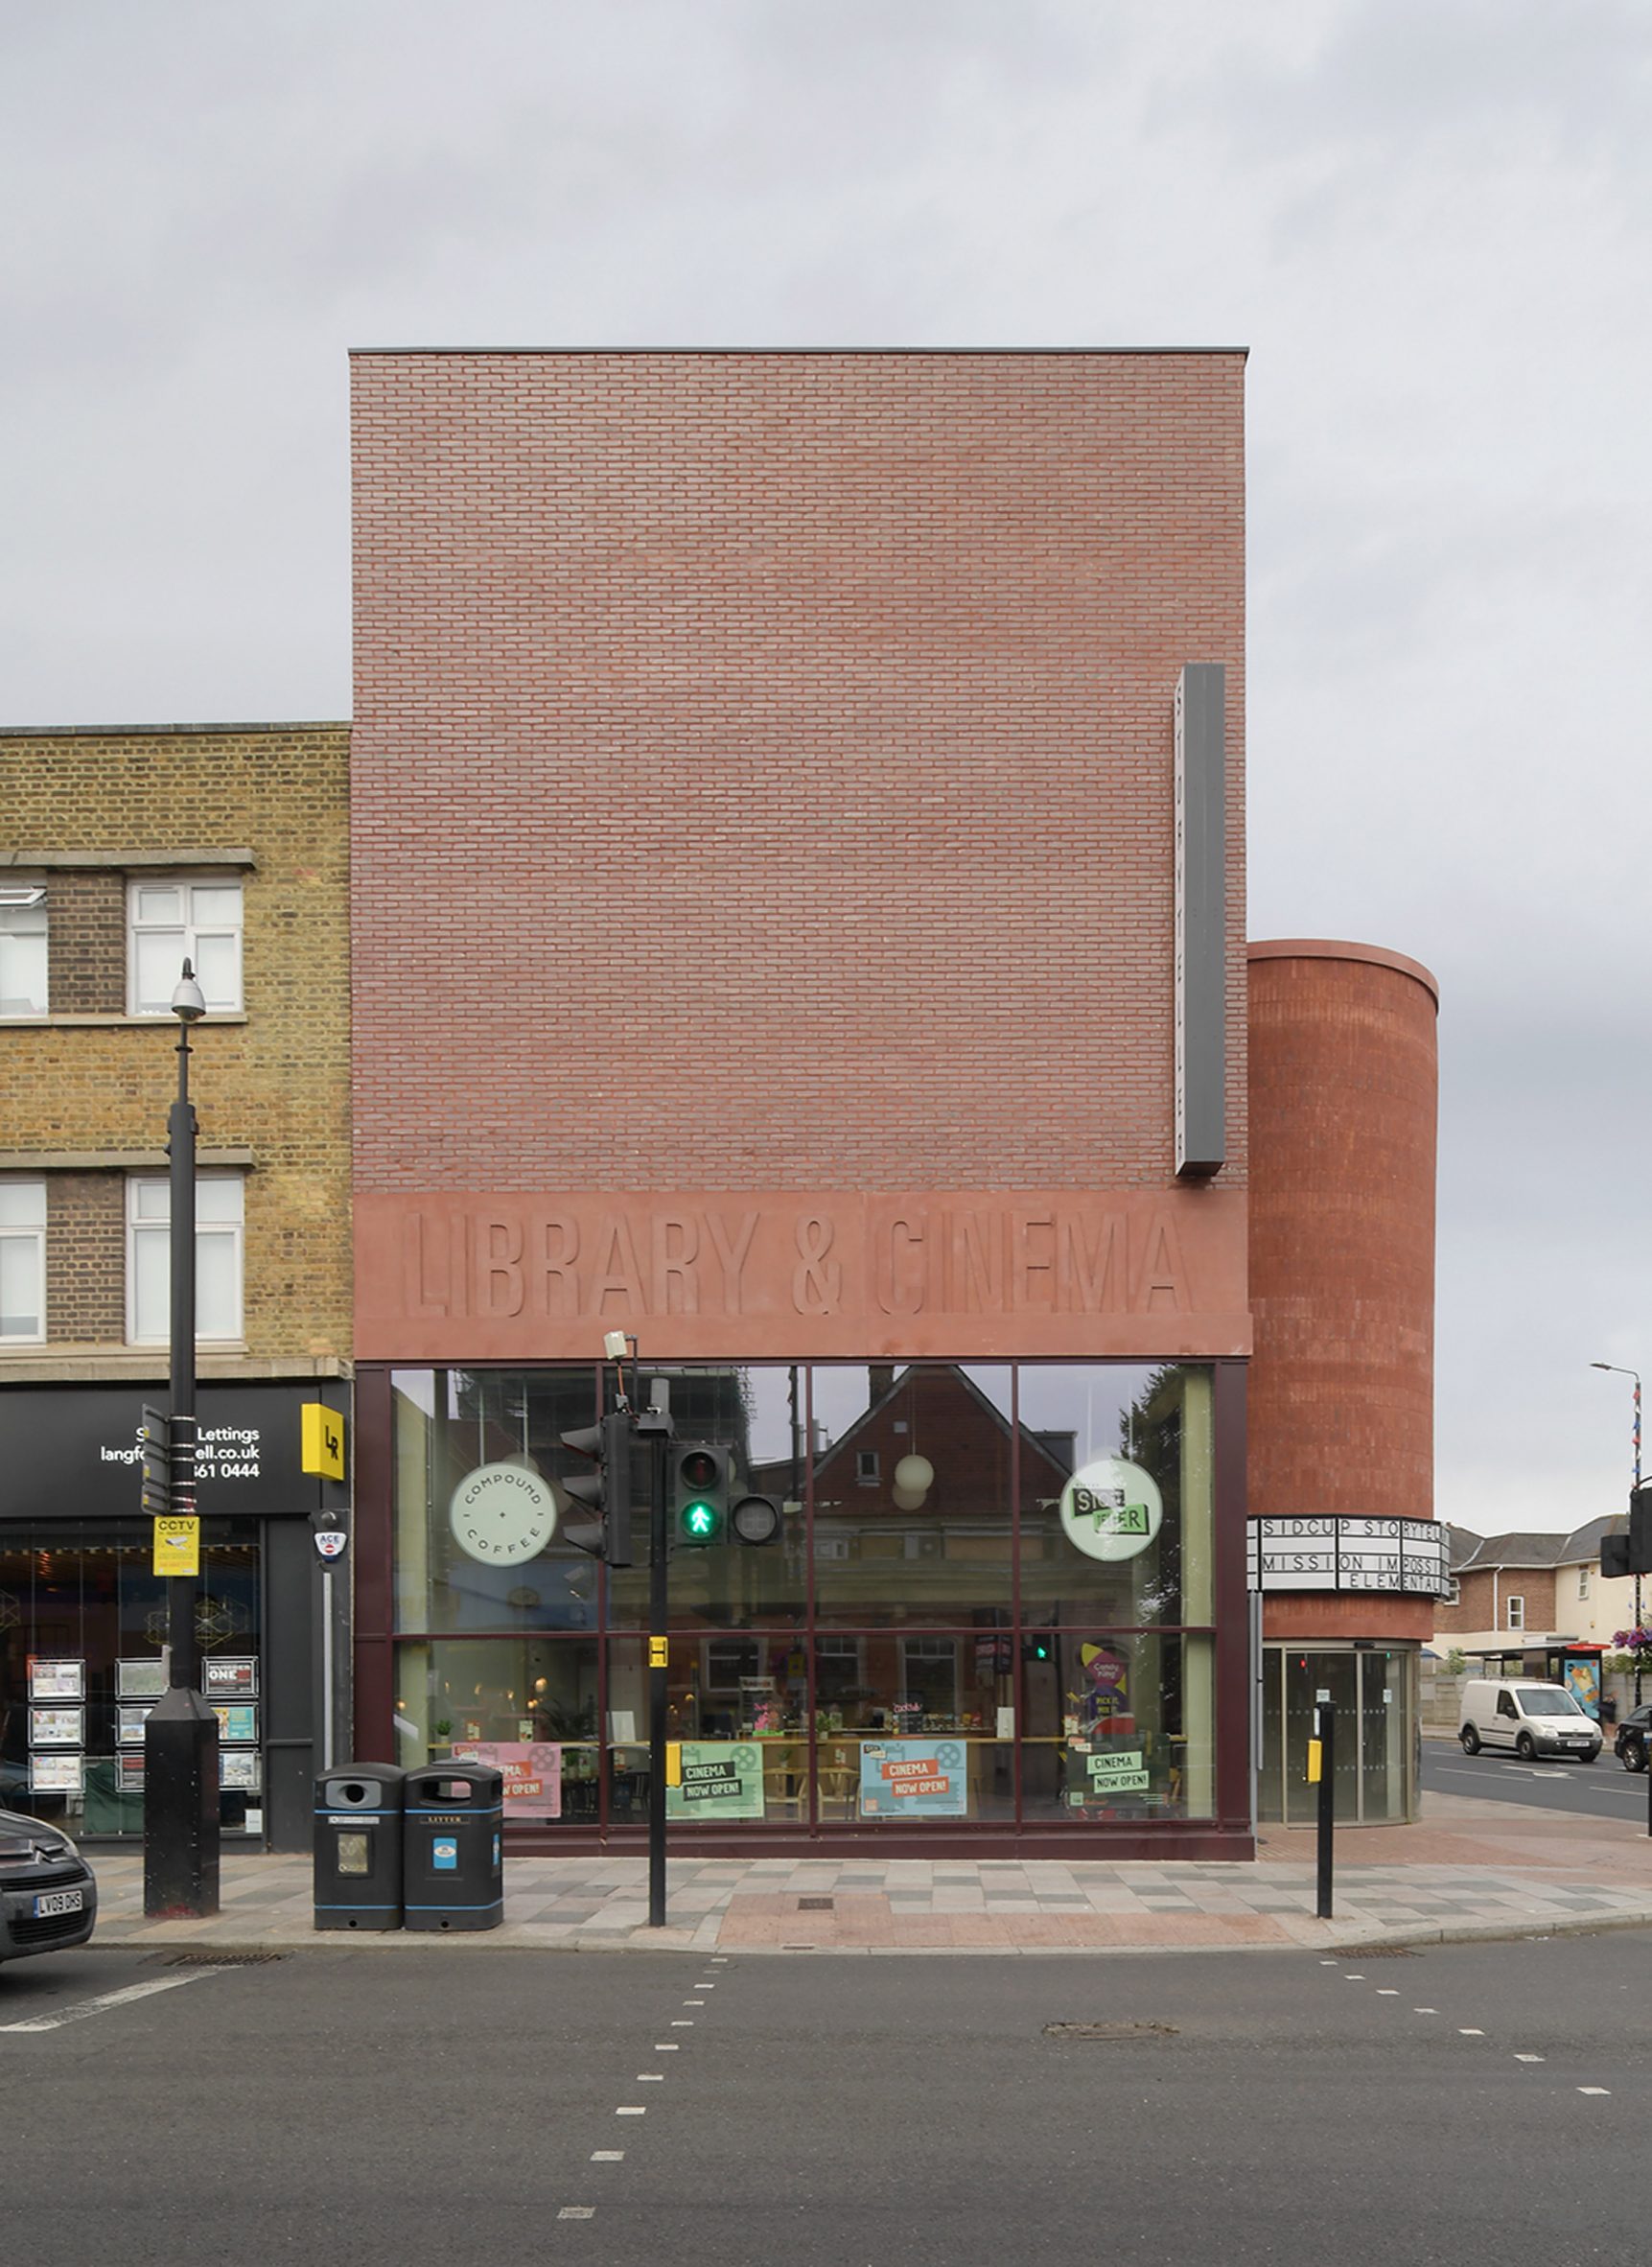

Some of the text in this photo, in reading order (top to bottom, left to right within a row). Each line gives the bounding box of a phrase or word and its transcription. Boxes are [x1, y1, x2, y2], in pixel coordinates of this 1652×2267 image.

[405, 1211, 1195, 1317] LIBRARY & CINEMA
[198, 1427, 260, 1444] Lettings
[221, 1463, 260, 1478] 0444
[465, 1474, 541, 1505] COMPOUND
[158, 1520, 196, 1531] CCTV
[1263, 1519, 1351, 1535] SIDCUP
[467, 1529, 540, 1554] COFFEE
[1262, 1555, 1362, 1571] MISSION
[1350, 1573, 1439, 1592] ELEMENTAL
[209, 1670, 238, 1680] ONE
[888, 1763, 929, 1777] CINEMA
[1094, 1756, 1133, 1769] CINEMA
[685, 1765, 727, 1780] CINEMA
[895, 1781, 946, 1795] NOW OPEN!
[1097, 1774, 1146, 1788] NOW OPEN!
[512, 1783, 540, 1795] OPEN!
[686, 1782, 739, 1798] NOW OPEN!
